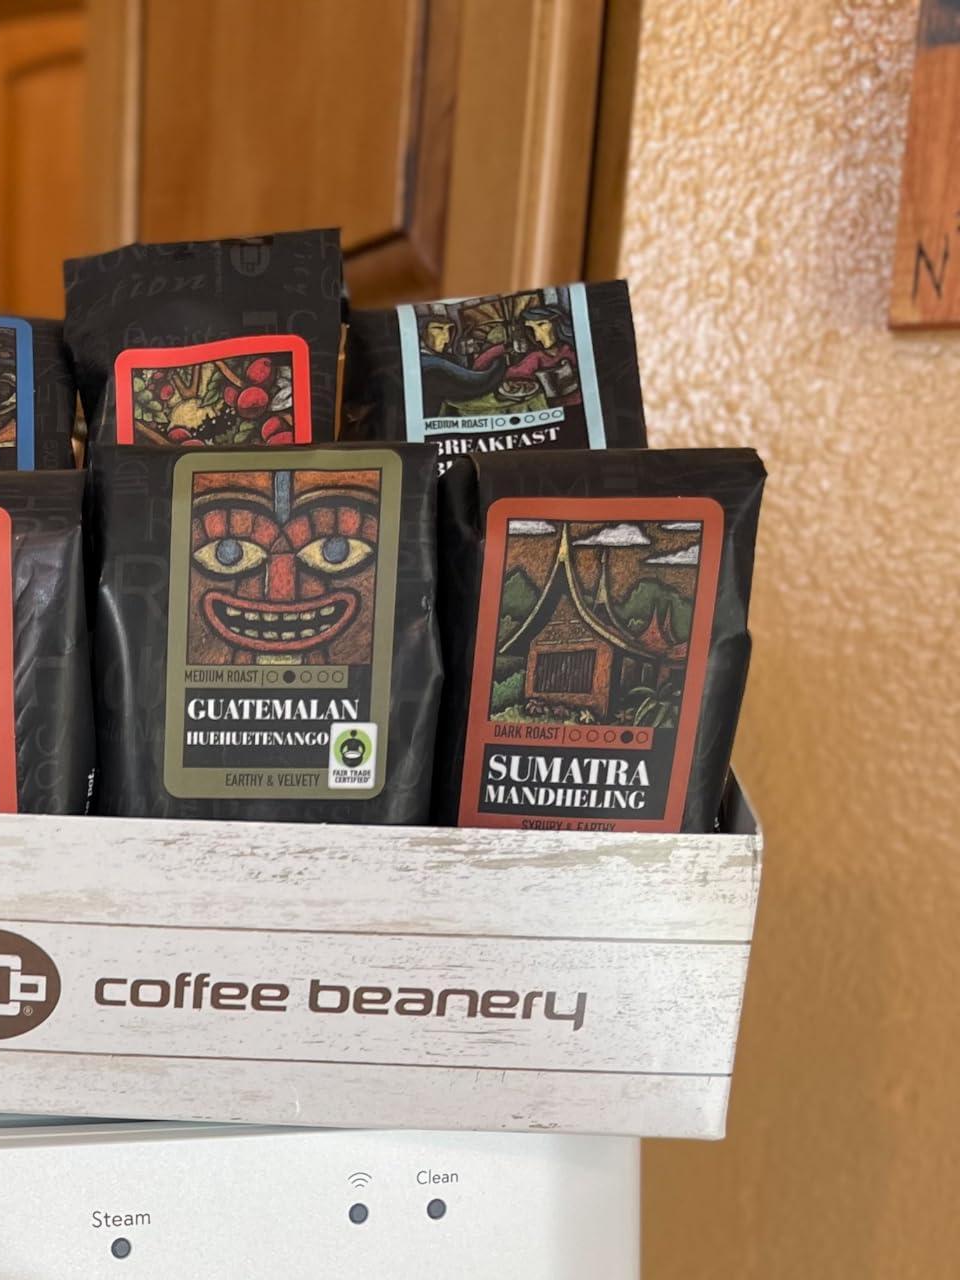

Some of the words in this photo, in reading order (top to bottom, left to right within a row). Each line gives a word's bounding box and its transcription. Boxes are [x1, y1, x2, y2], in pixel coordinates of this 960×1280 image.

[424, 420, 459, 431] MEDIUM
[461, 418, 488, 429] ROAST
[184, 670, 224, 683] MEDIUM
[227, 670, 259, 683] ROAST
[187, 699, 359, 720] GUATEMALAN
[186, 730, 329, 746] HUEHUETENANGO
[494, 725, 523, 739] DARK
[525, 727, 560, 741] ROAST
[332, 769, 348, 777] FAIR
[350, 769, 372, 777] TRADE
[488, 753, 650, 786] SUMATRA
[225, 773, 264, 787] EARTHY
[267, 774, 274, 786] &
[277, 773, 321, 787] VELVETY
[484, 784, 645, 809] MANDHELING
[94, 972, 290, 1013] coffee
[308, 978, 587, 1032] beanery
[416, 1169, 460, 1185] Clean
[92, 1209, 152, 1229] Steam
